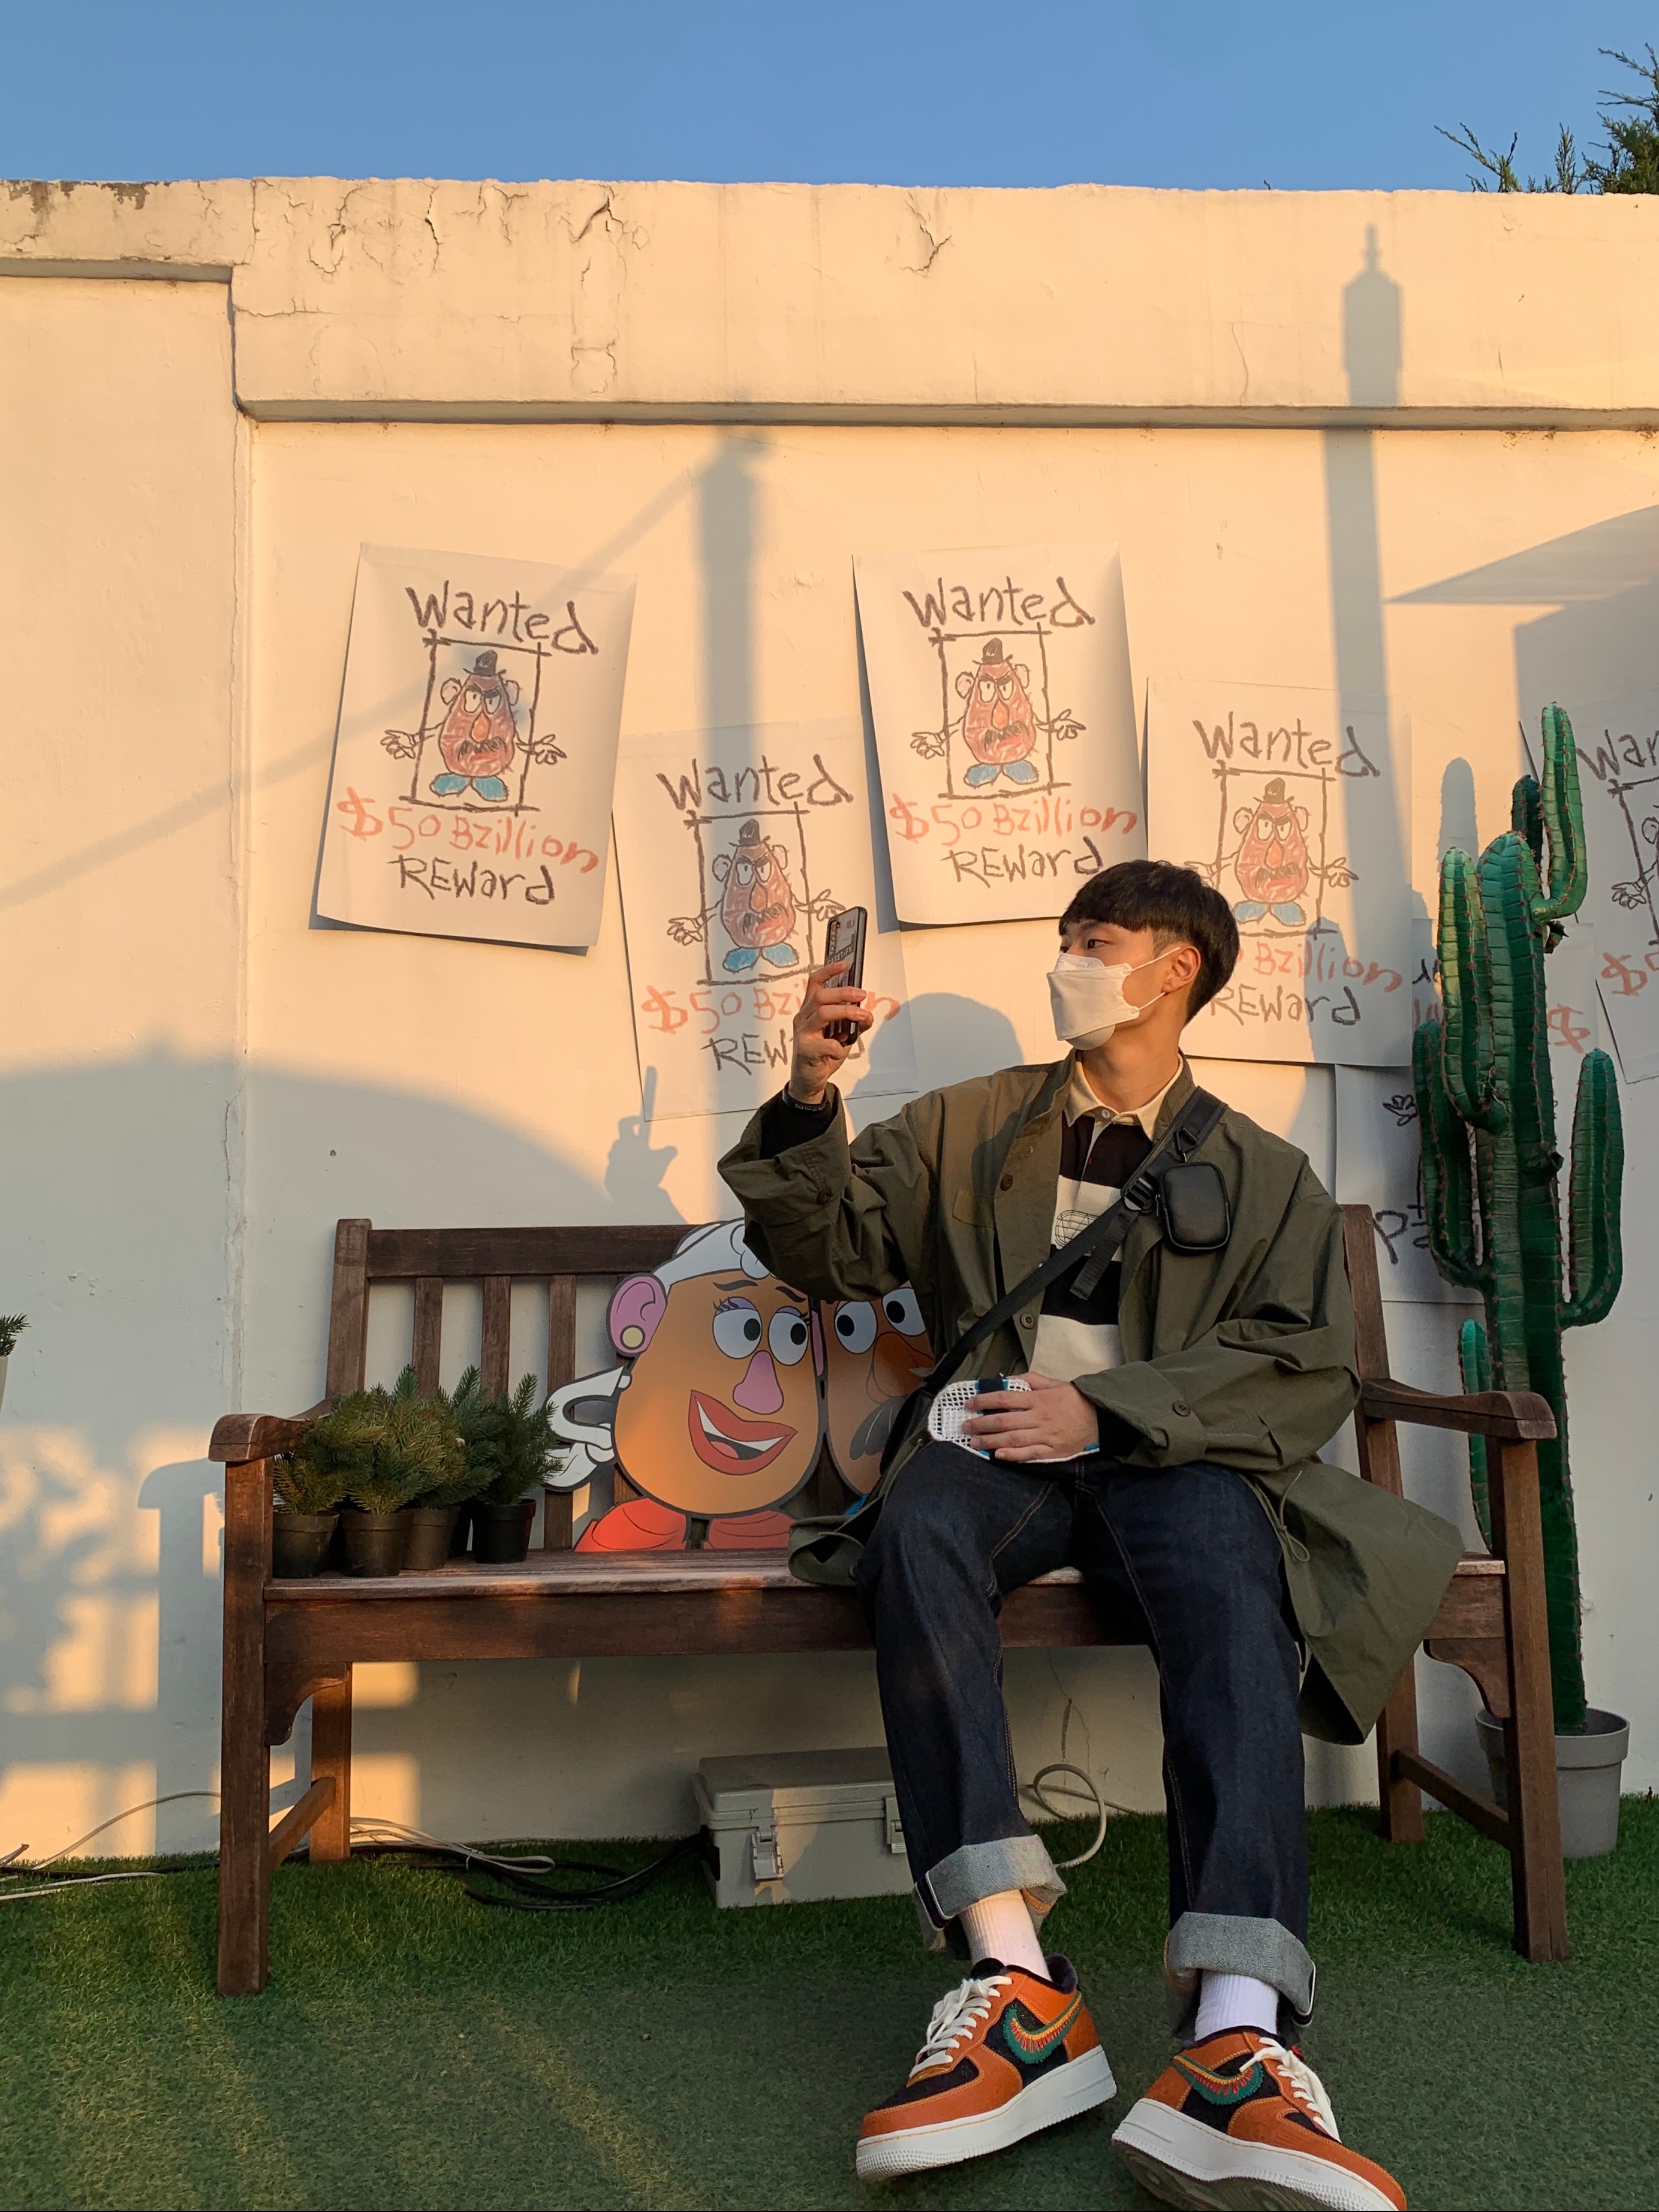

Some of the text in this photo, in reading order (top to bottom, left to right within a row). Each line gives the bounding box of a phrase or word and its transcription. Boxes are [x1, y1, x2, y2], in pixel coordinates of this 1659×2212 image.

[405, 580, 599, 655] Wanted
[902, 576, 1095, 628] Wanted
[1191, 710, 1381, 777] Wanted
[655, 753, 854, 812] Wanted
[336, 786, 599, 874] $50 Bzillion
[889, 793, 1137, 846] $50 Bzillion
[1253, 940, 1404, 993] Bzillion
[640, 985, 743, 1035] $50
